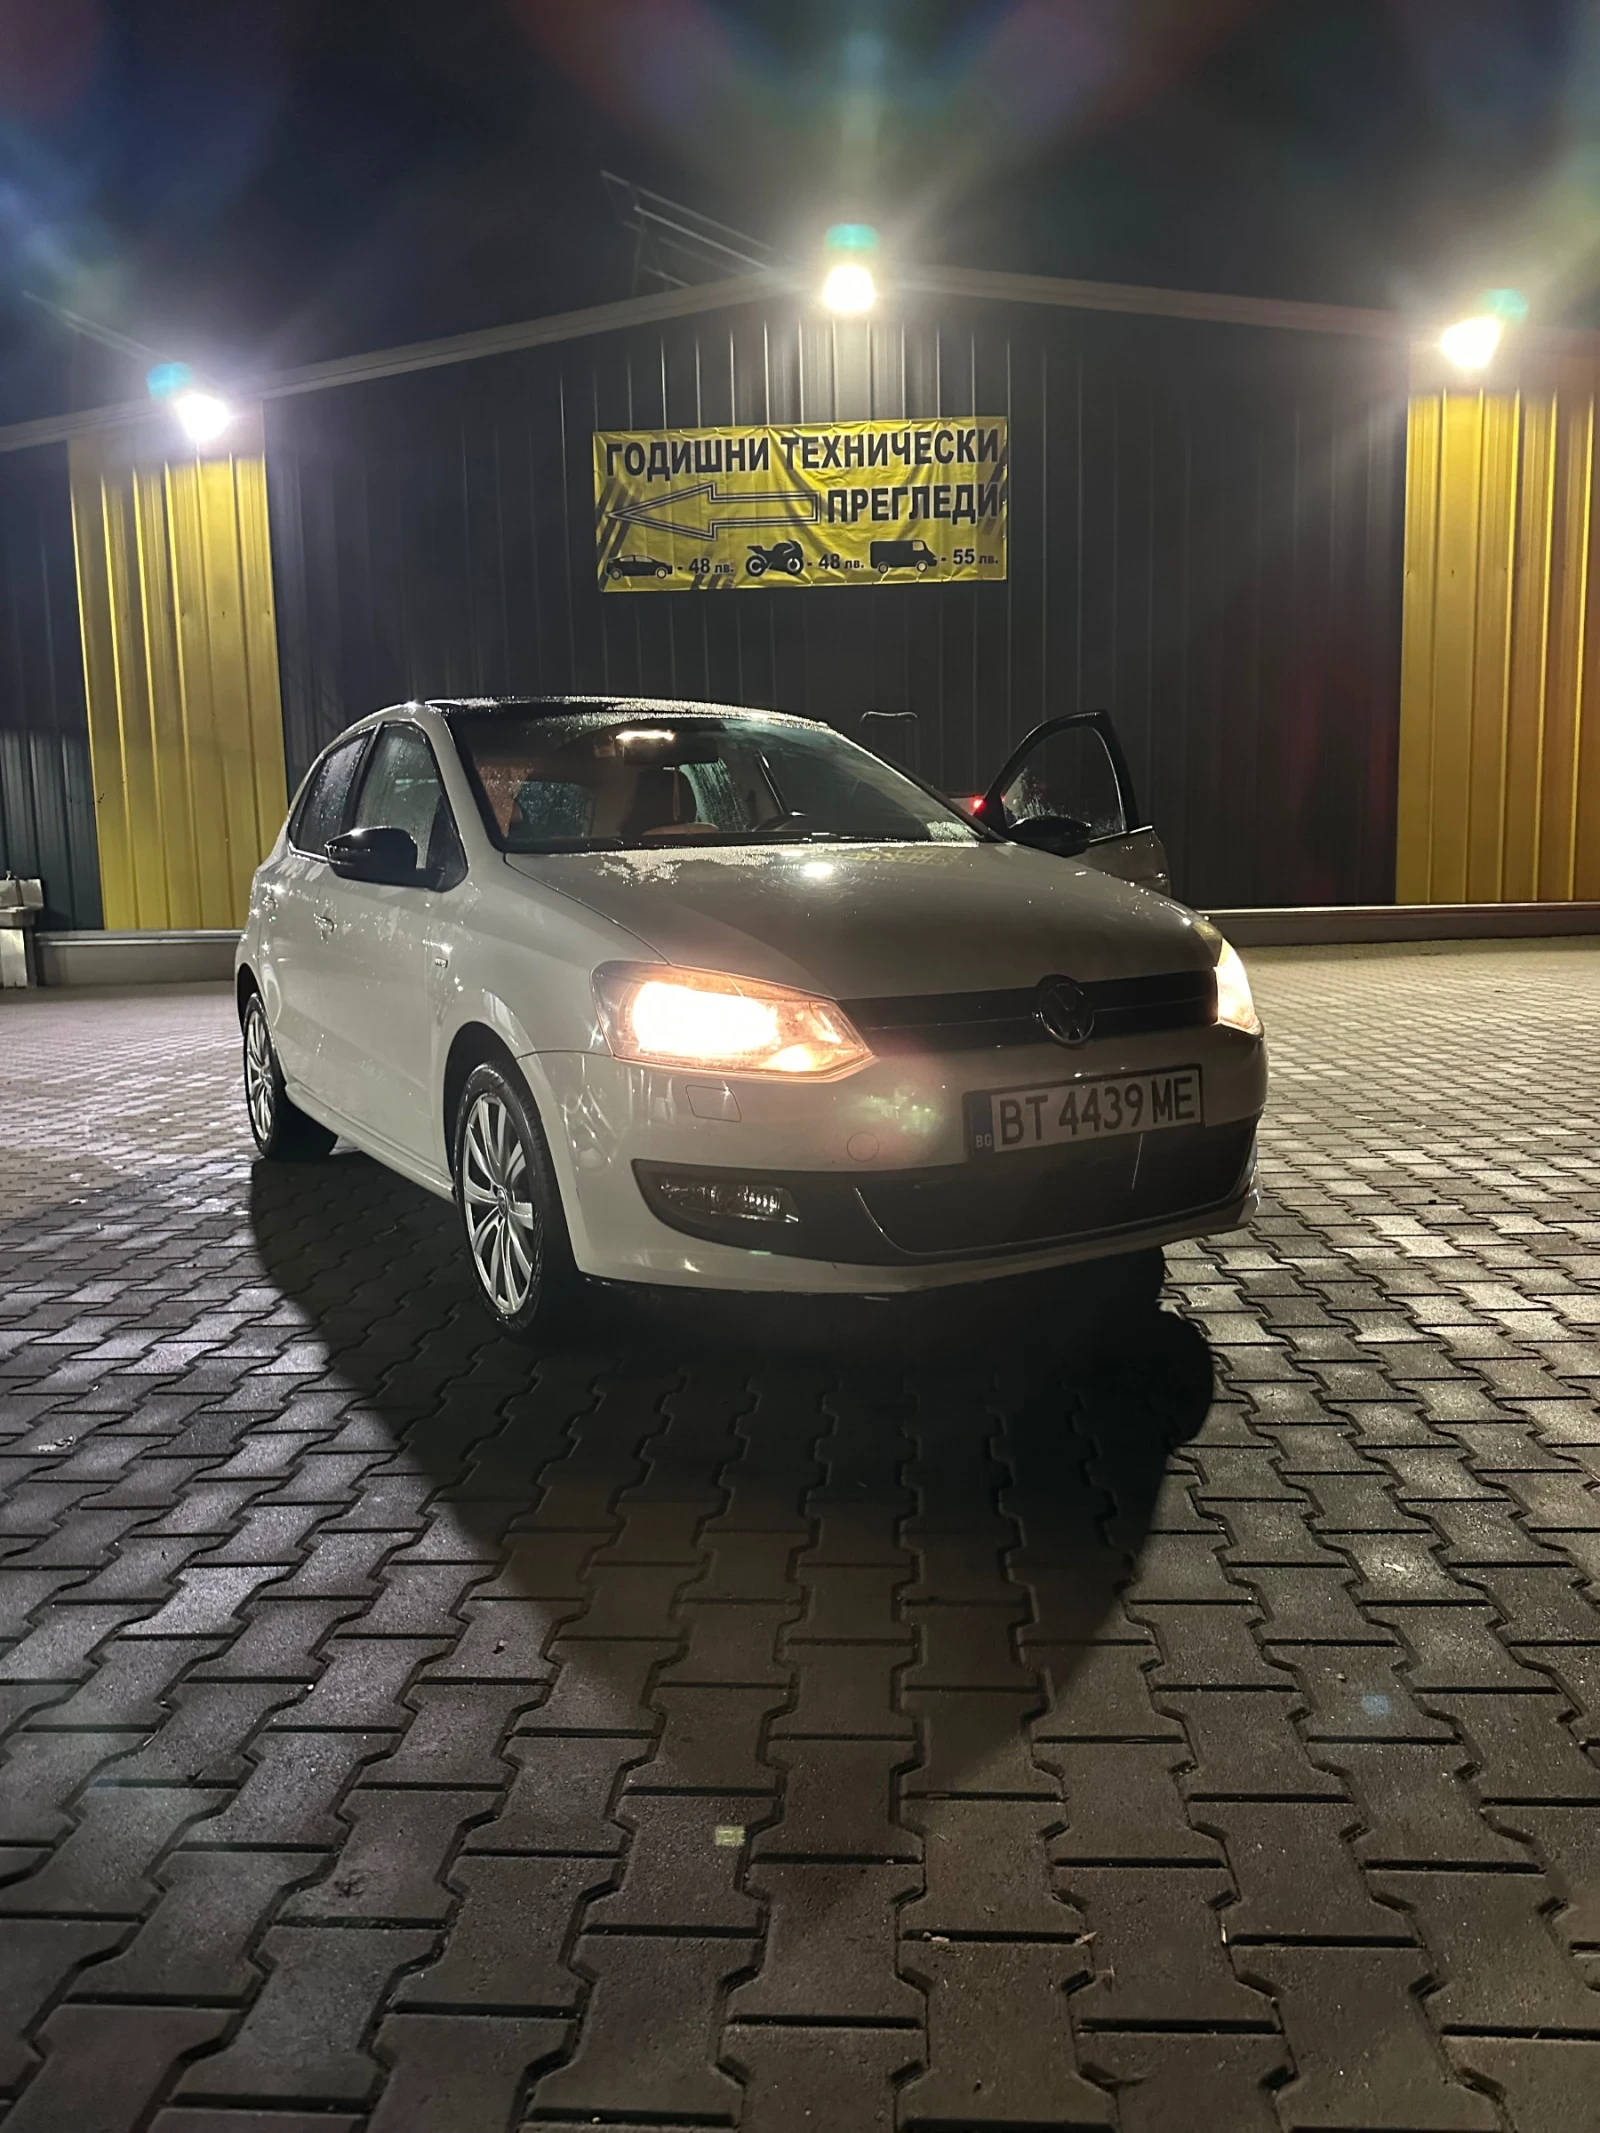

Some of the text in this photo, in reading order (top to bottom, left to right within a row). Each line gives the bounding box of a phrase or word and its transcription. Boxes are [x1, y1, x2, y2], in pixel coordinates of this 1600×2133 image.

[606, 428, 999, 482] ГОДИШНИ ТЕХНИЧЕСКИ
[827, 483, 999, 525] ПРЕГЛЕДИ
[818, 553, 841, 569] 48
[844, 559, 865, 569] лв.
[952, 548, 975, 565] 55
[979, 554, 999, 564] лв.
[688, 557, 711, 574] 48
[714, 563, 734, 574] лв.
[1001, 1076, 1196, 1146] BT 4439 ME
[975, 1133, 992, 1148] BG
